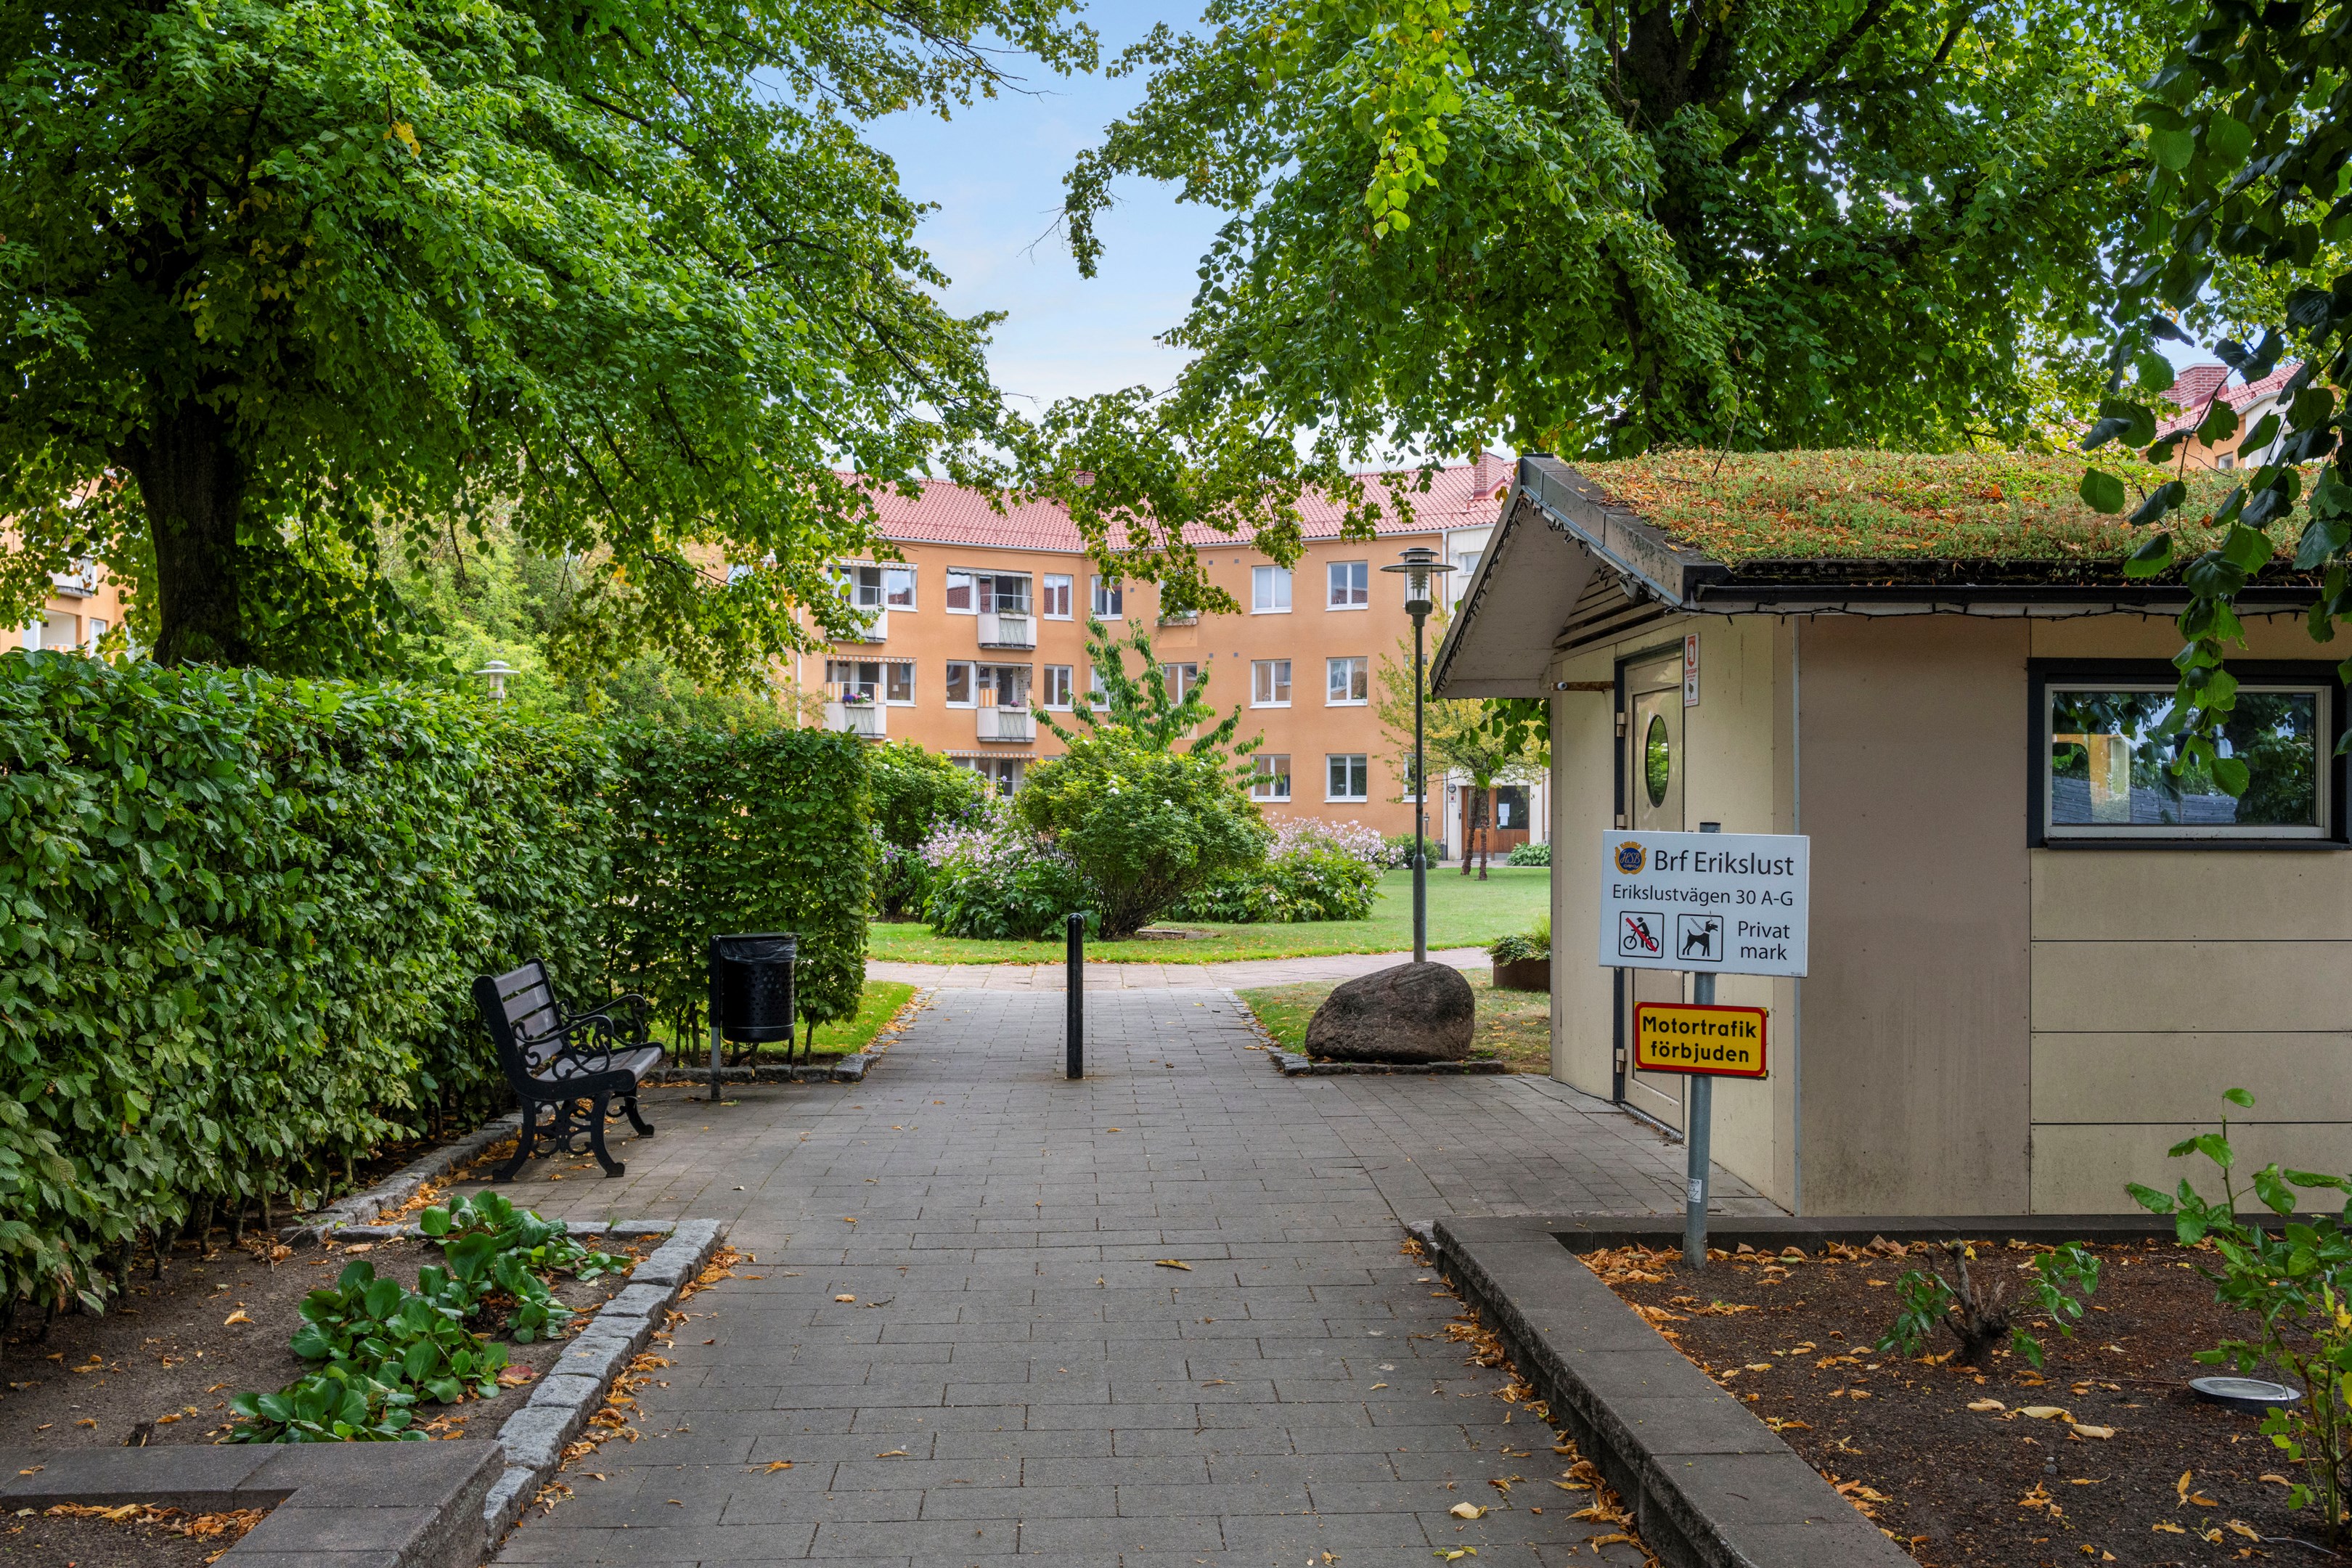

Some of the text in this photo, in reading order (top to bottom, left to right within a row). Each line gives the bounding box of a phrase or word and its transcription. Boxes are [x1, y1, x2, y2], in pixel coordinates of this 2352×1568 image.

[1620, 852, 1641, 864] HSB
[1655, 850, 1794, 875] Brf Erikslust
[1613, 884, 1792, 906] Erikslustvägen 30 A-G
[1739, 921, 1789, 939] Privat
[1741, 944, 1787, 960] mark
[1643, 1016, 1756, 1037] Motortrafik
[1651, 1041, 1749, 1063] förbjuden
